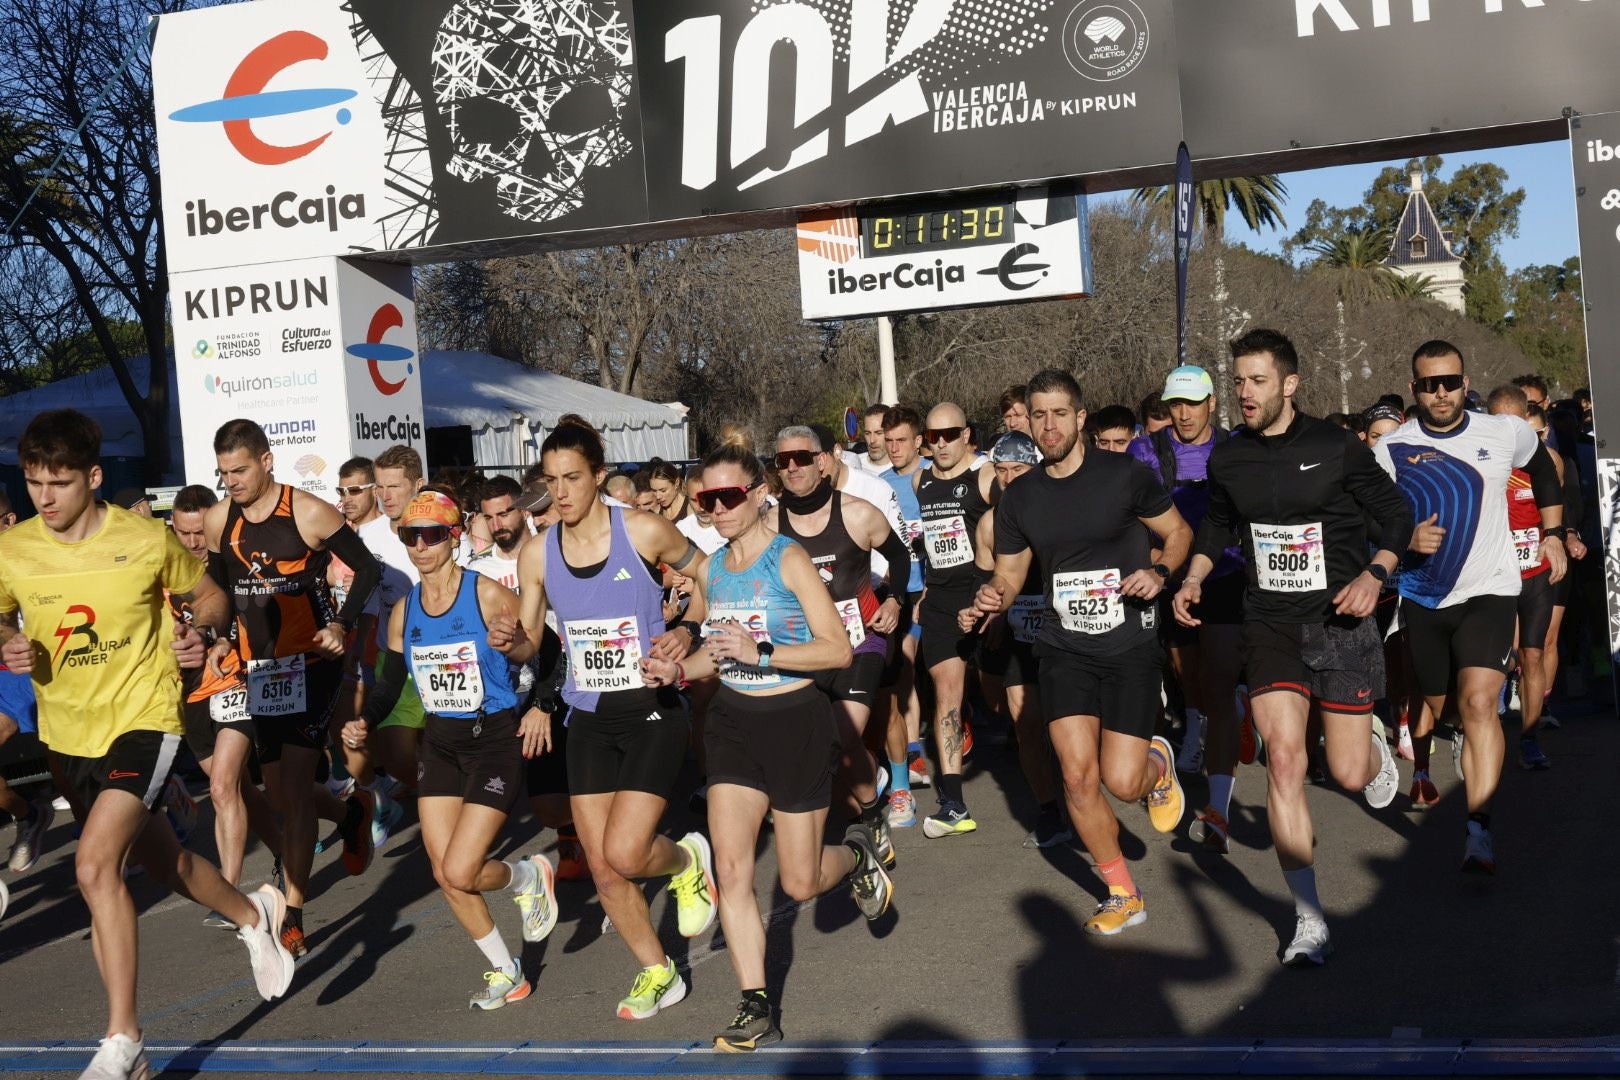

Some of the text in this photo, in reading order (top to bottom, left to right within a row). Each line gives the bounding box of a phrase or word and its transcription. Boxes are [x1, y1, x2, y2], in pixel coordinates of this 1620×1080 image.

[1089, 50, 1126, 60] ATHLETICS
[1094, 45, 1119, 53] WORLD
[1107, 65, 1126, 77] ROAD
[665, 0, 952, 191] 10K
[932, 81, 1028, 110] VALENCIA
[933, 92, 1137, 133] IBERCAJA By KIPRUN
[184, 184, 366, 238] iberCaja
[873, 206, 1004, 249] 0:11:30
[827, 258, 965, 294] iberCaja
[185, 276, 329, 321] KIPRUN
[282, 327, 321, 340] Cultura
[216, 338, 261, 351] TRINIDAD
[281, 338, 332, 353] Esfuerzo
[218, 347, 261, 360] ALFONSO
[260, 419, 316, 435] YUNDAI
[355, 412, 421, 447] iberCaja
[287, 435, 317, 445] Motor
[1254, 529, 1294, 541] iberCaja
[934, 538, 958, 554] 6918
[1516, 547, 1530, 560] 28
[936, 555, 964, 566] KIPRUN
[1268, 552, 1309, 572] 6908
[234, 582, 299, 596] San Antonio
[1056, 577, 1094, 588] iberCaja
[1269, 578, 1312, 588] KIPRUN
[1068, 597, 1108, 616] 5523
[1022, 616, 1042, 630] 712
[1073, 619, 1112, 631] KIPRUN
[568, 626, 608, 637] iberCaja
[413, 651, 449, 662] iberCaja
[584, 648, 626, 670] 6662
[250, 663, 282, 674] iberCaja
[724, 669, 764, 680] KIPRUN
[429, 672, 467, 692] 6472
[586, 676, 630, 688] KIPRUN
[261, 680, 293, 700] 6316
[222, 691, 247, 710] 327
[433, 698, 472, 708] KIPRUN
[257, 702, 295, 713] KIPRUN
[222, 710, 251, 721] KIPR
